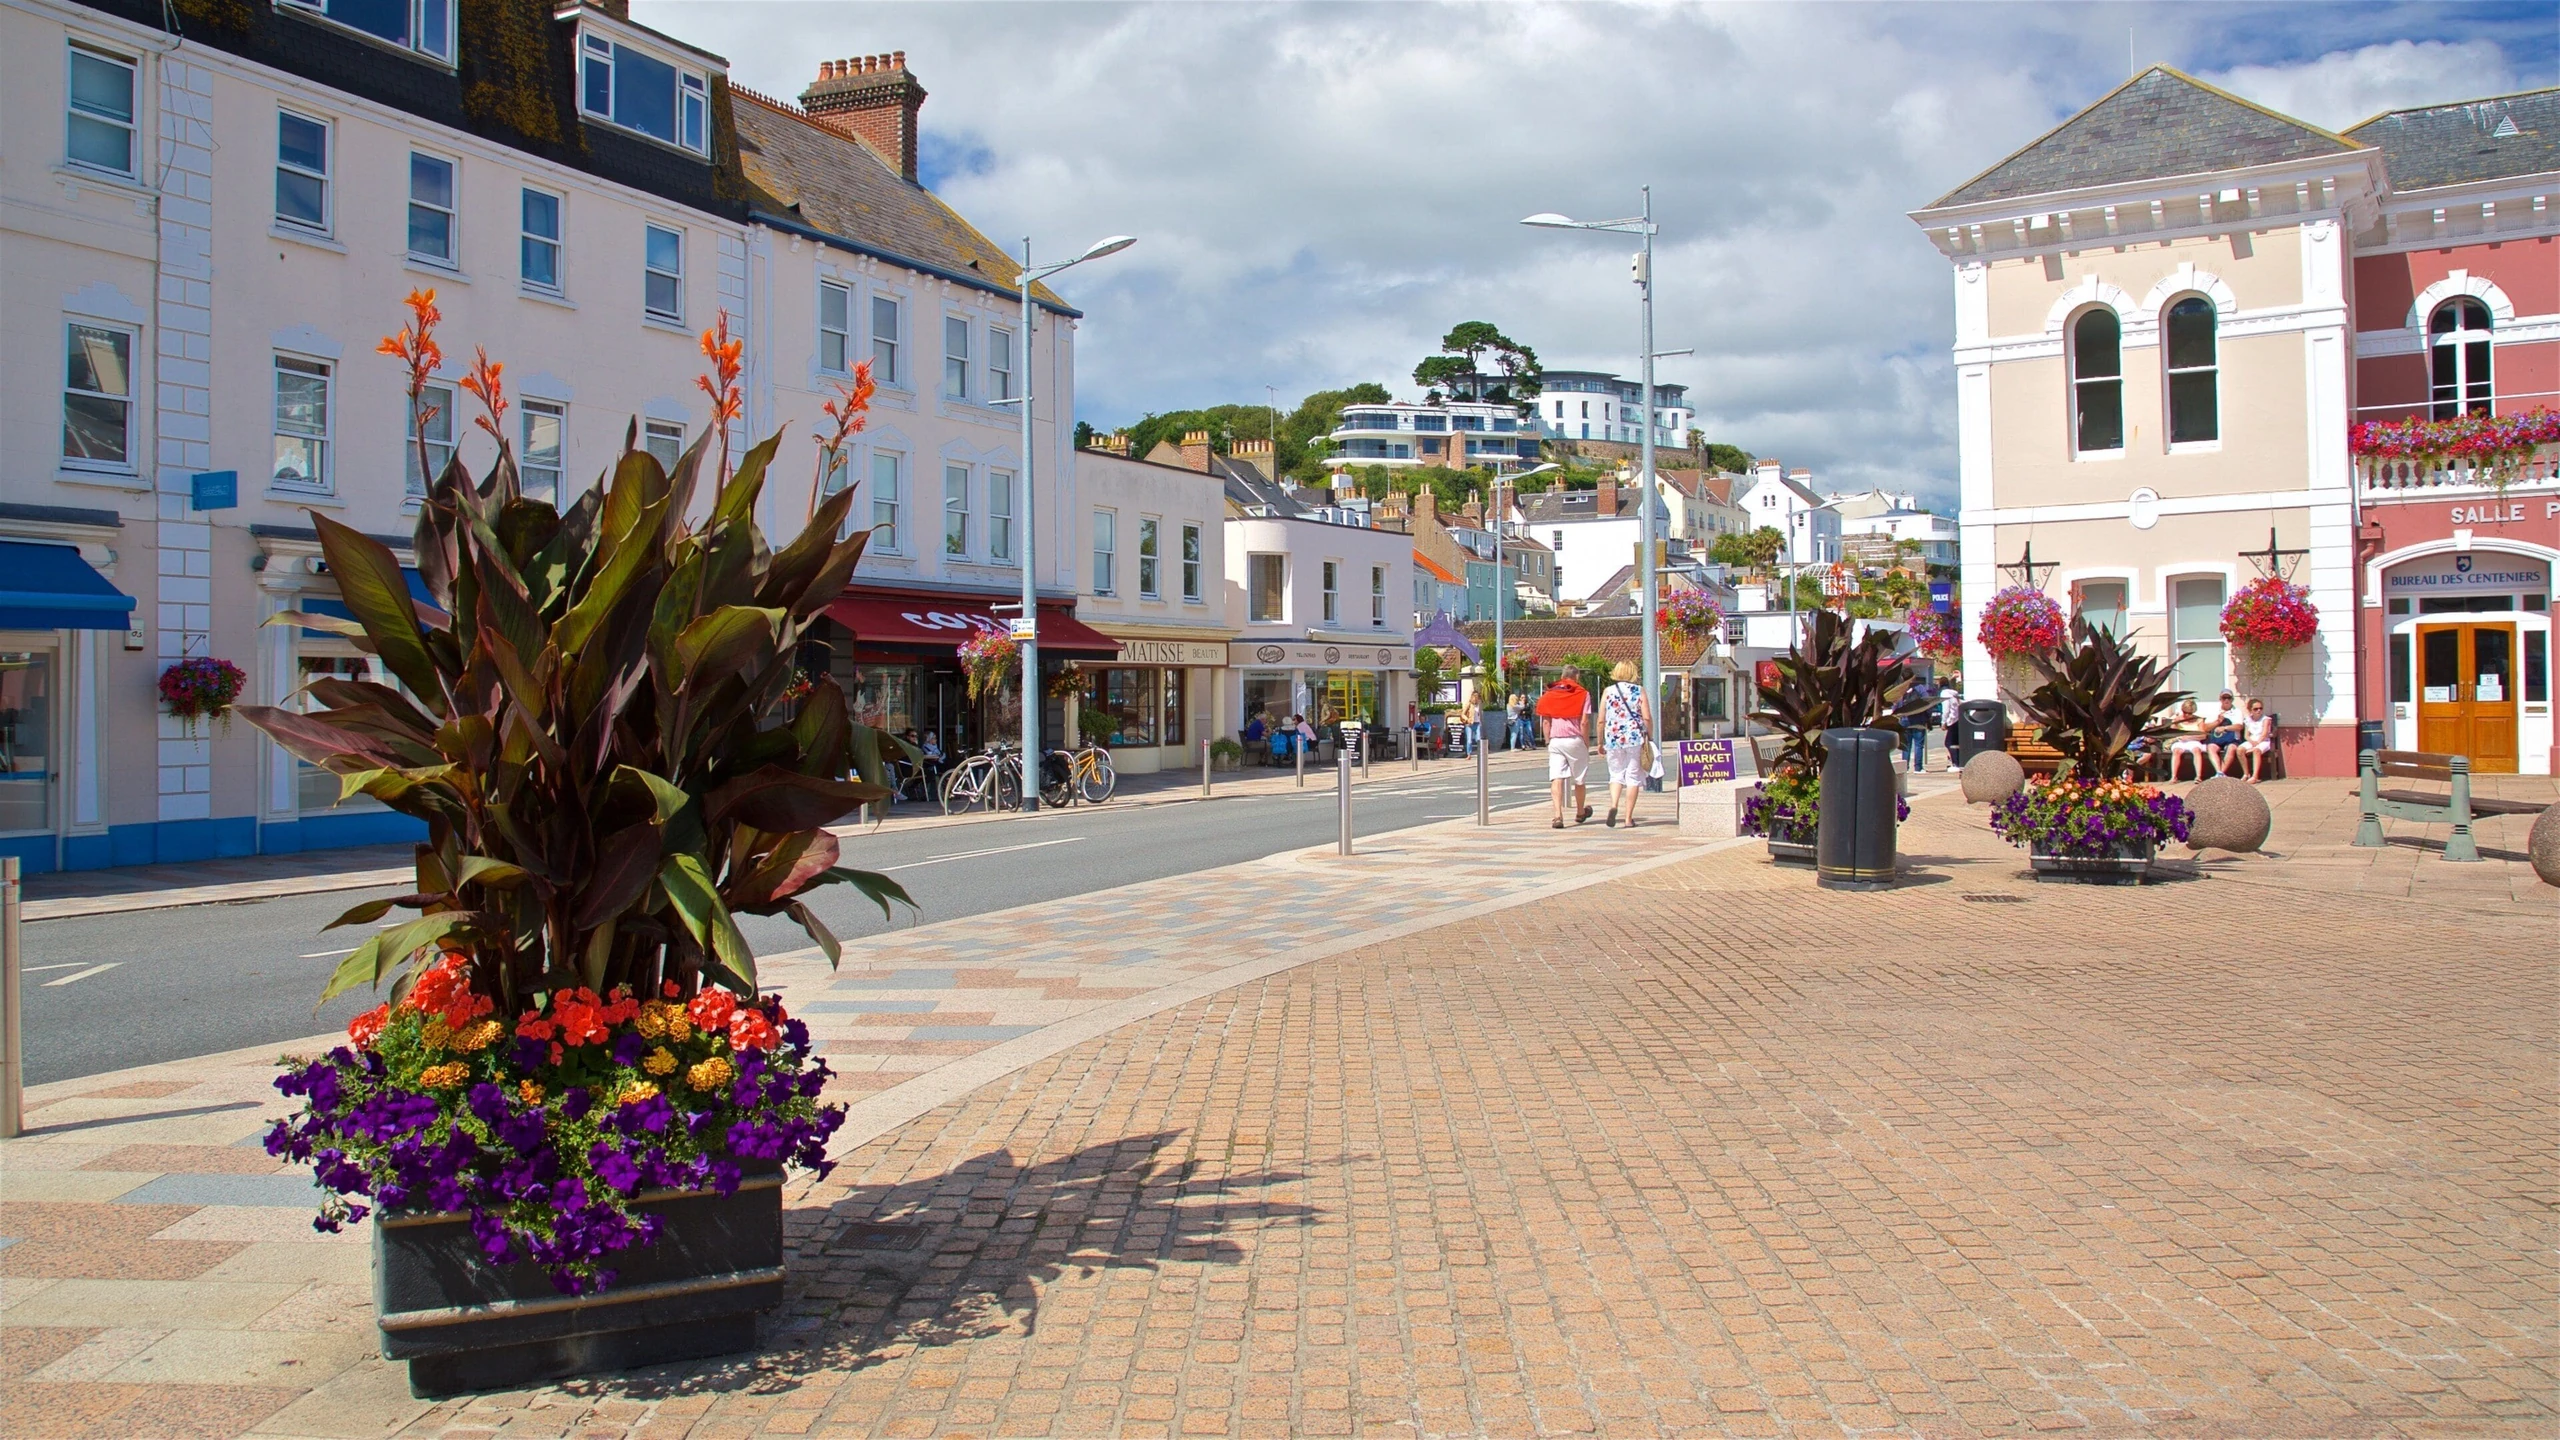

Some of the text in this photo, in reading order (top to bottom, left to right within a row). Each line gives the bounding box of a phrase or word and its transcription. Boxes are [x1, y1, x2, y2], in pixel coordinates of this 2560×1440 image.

[2451, 504, 2525, 524] SALLE
[2391, 571, 2541, 586] BUREAU DES CENTENIERS
[1932, 593, 1949, 602] POLICE
[1123, 641, 1219, 663] MATISSE BEAUTY
[1687, 742, 1726, 752] LOCAL
[1683, 753, 1731, 764] MARKET
[1688, 771, 1701, 779] ST.
